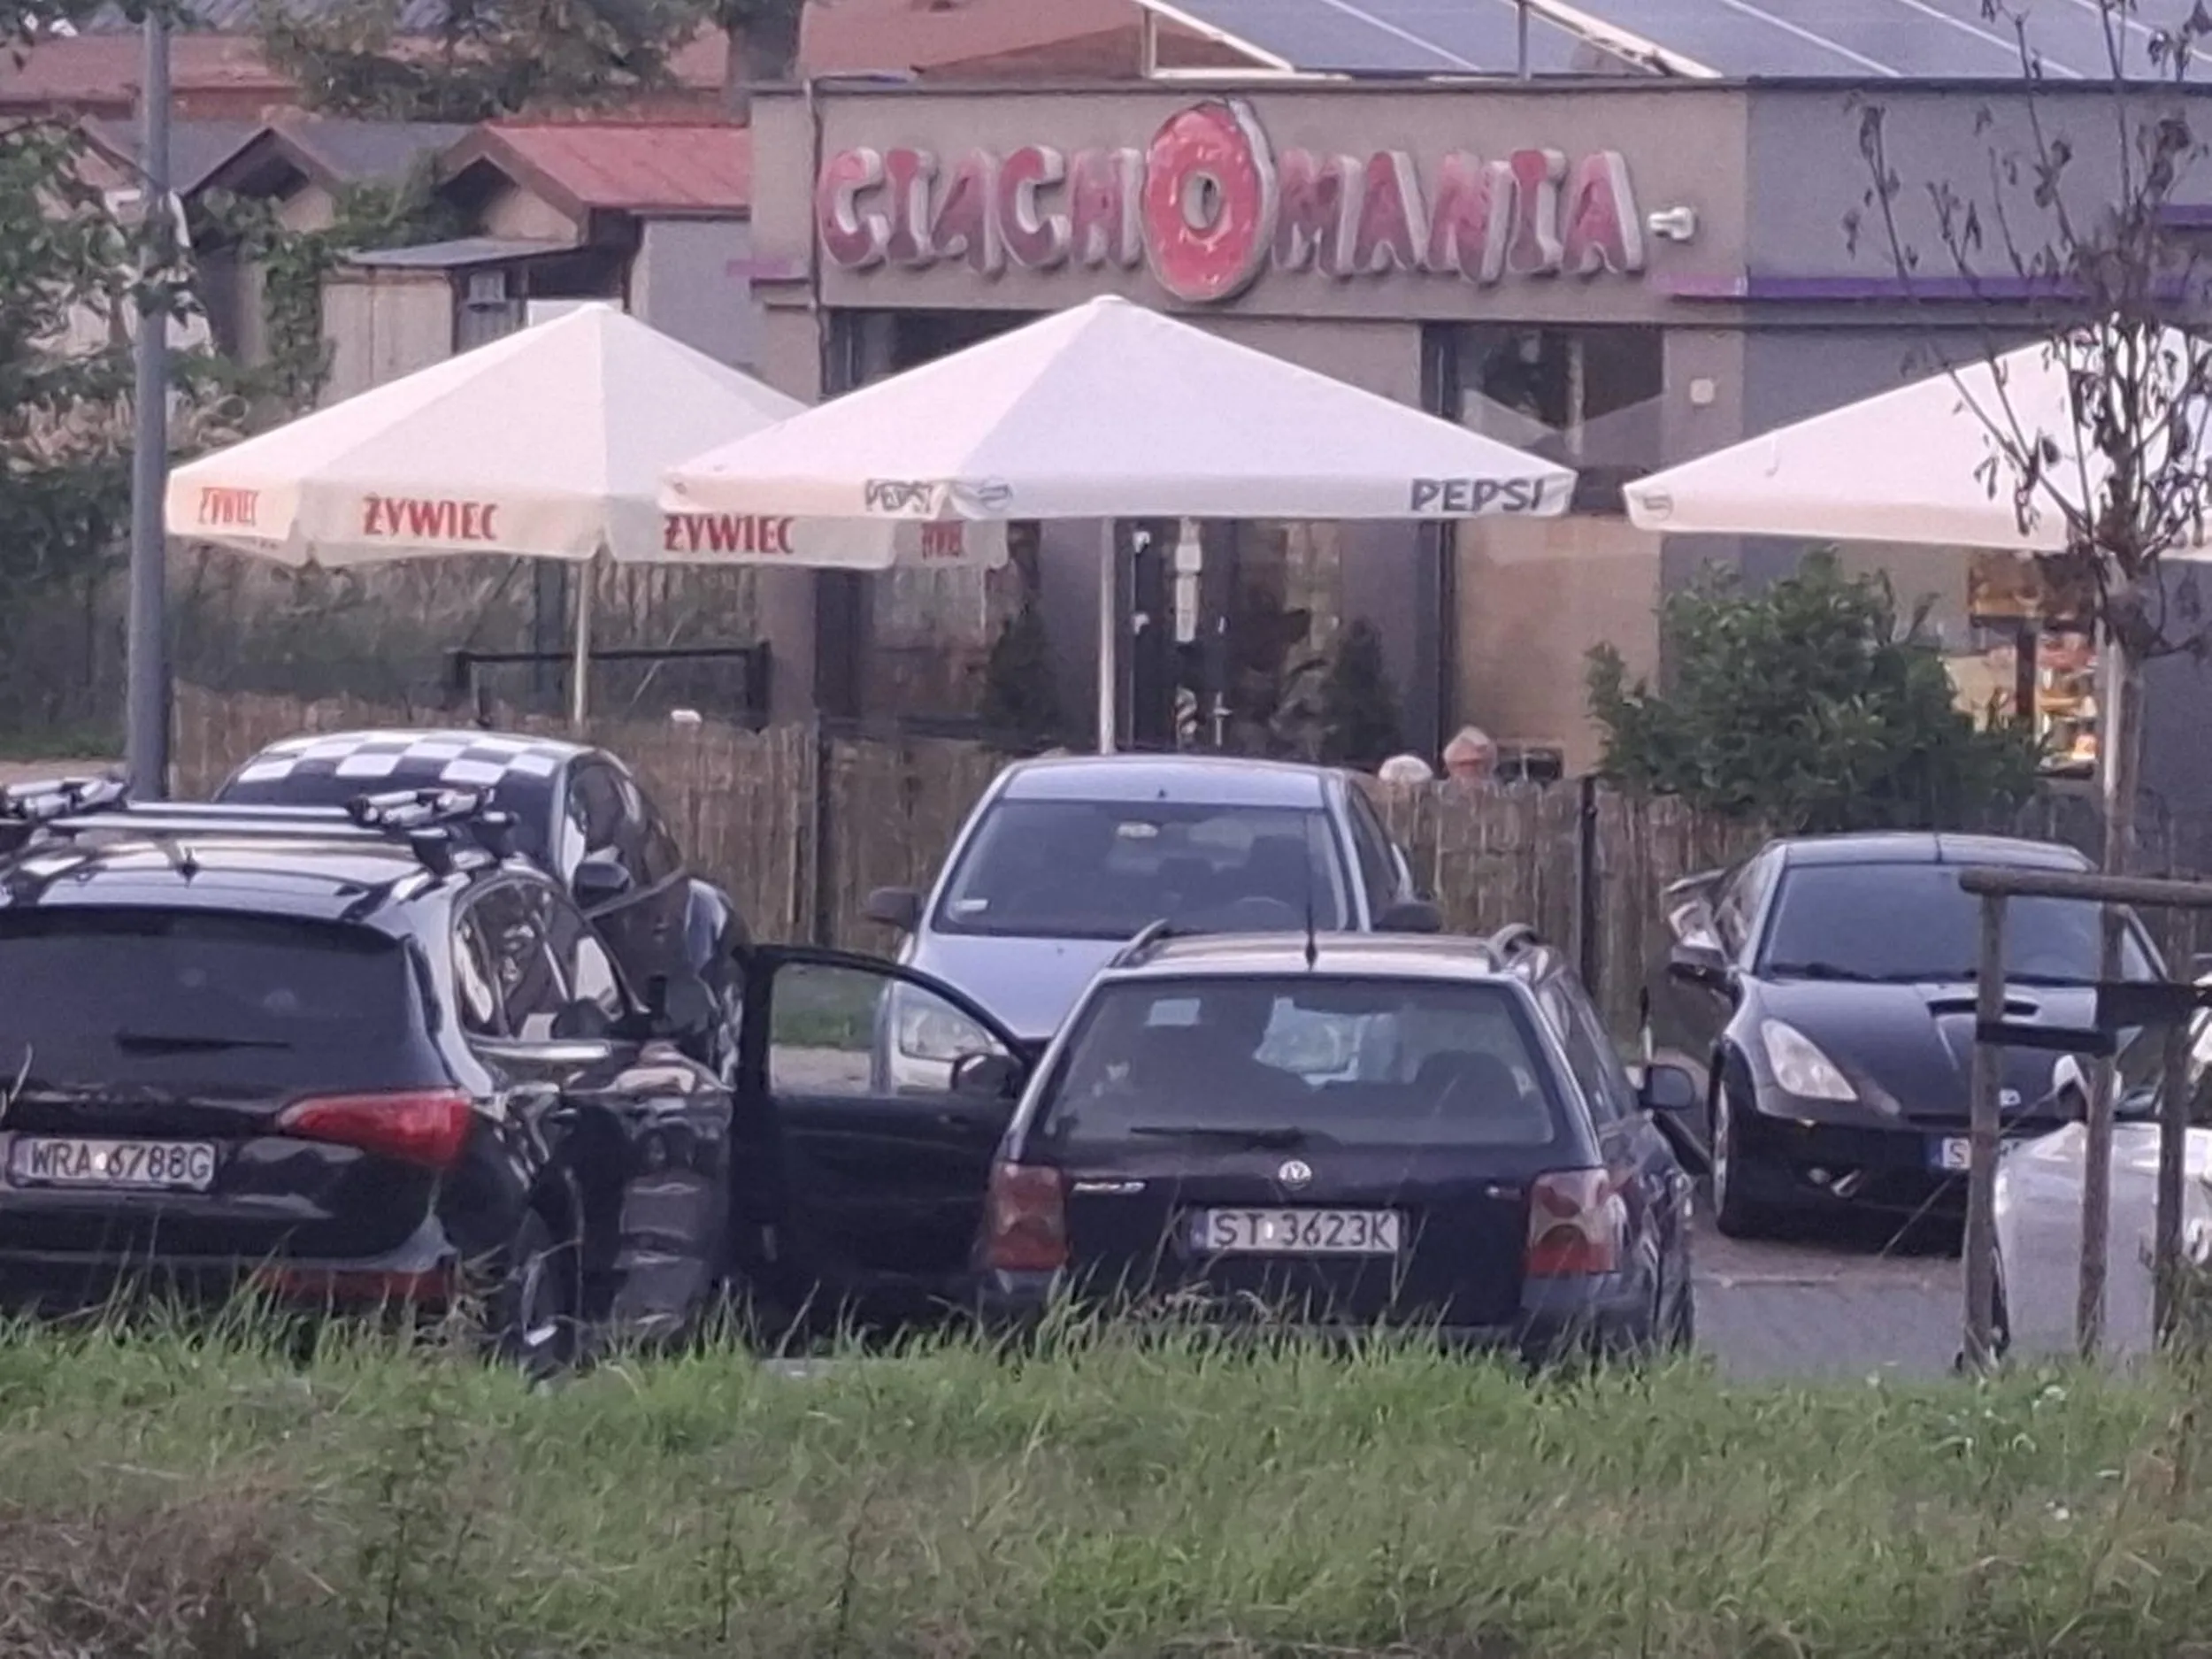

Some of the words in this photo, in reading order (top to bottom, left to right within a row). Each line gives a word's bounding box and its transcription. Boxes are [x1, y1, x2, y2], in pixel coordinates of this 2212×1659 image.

[1411, 477, 1545, 512] PEPSI
[32, 1141, 89, 1176] WRA
[106, 1144, 210, 1181] 6788G
[1213, 1212, 1265, 1247] ST
[1279, 1210, 1392, 1248] 3623K
